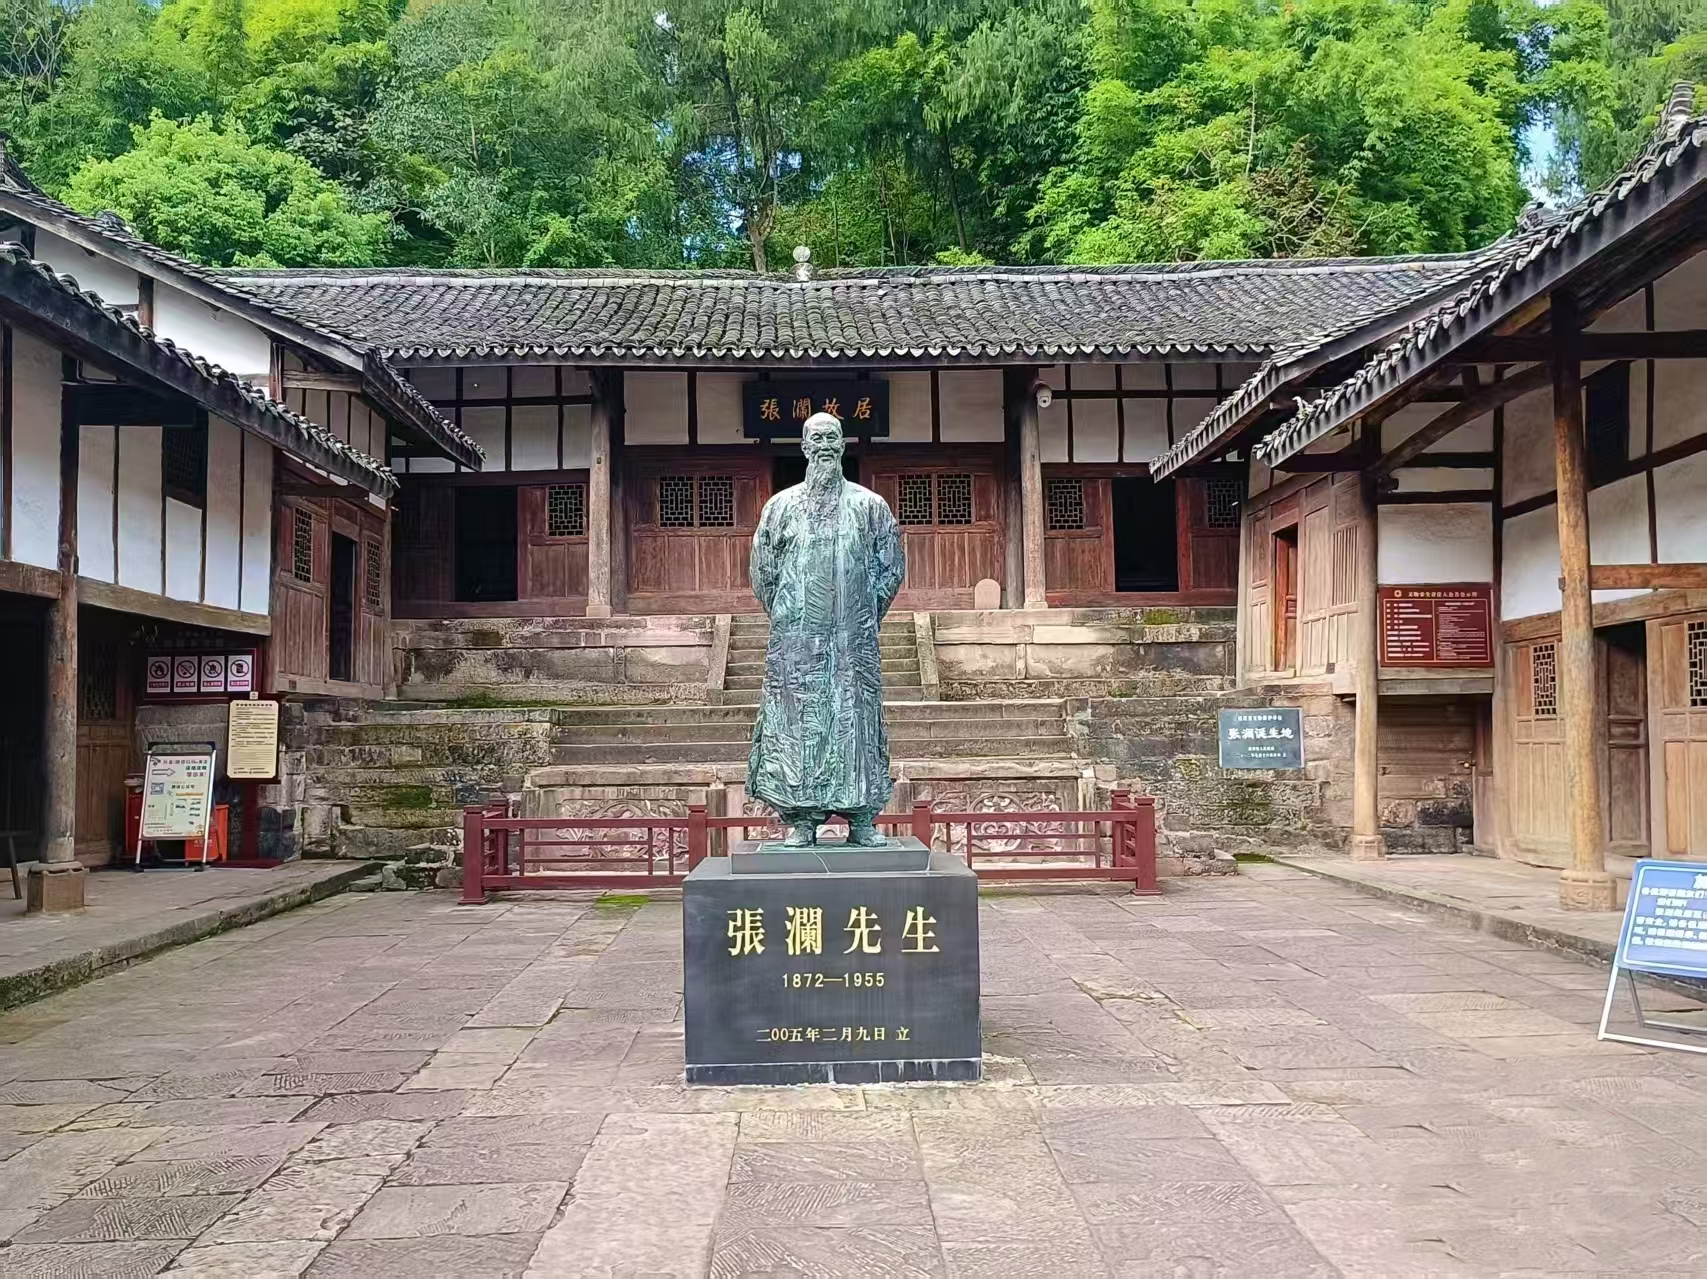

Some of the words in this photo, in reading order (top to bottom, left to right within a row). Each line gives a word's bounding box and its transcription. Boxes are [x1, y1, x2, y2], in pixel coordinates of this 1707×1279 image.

[760, 397, 873, 421] 張瀾故居
[727, 906, 940, 956] 張瀾先生
